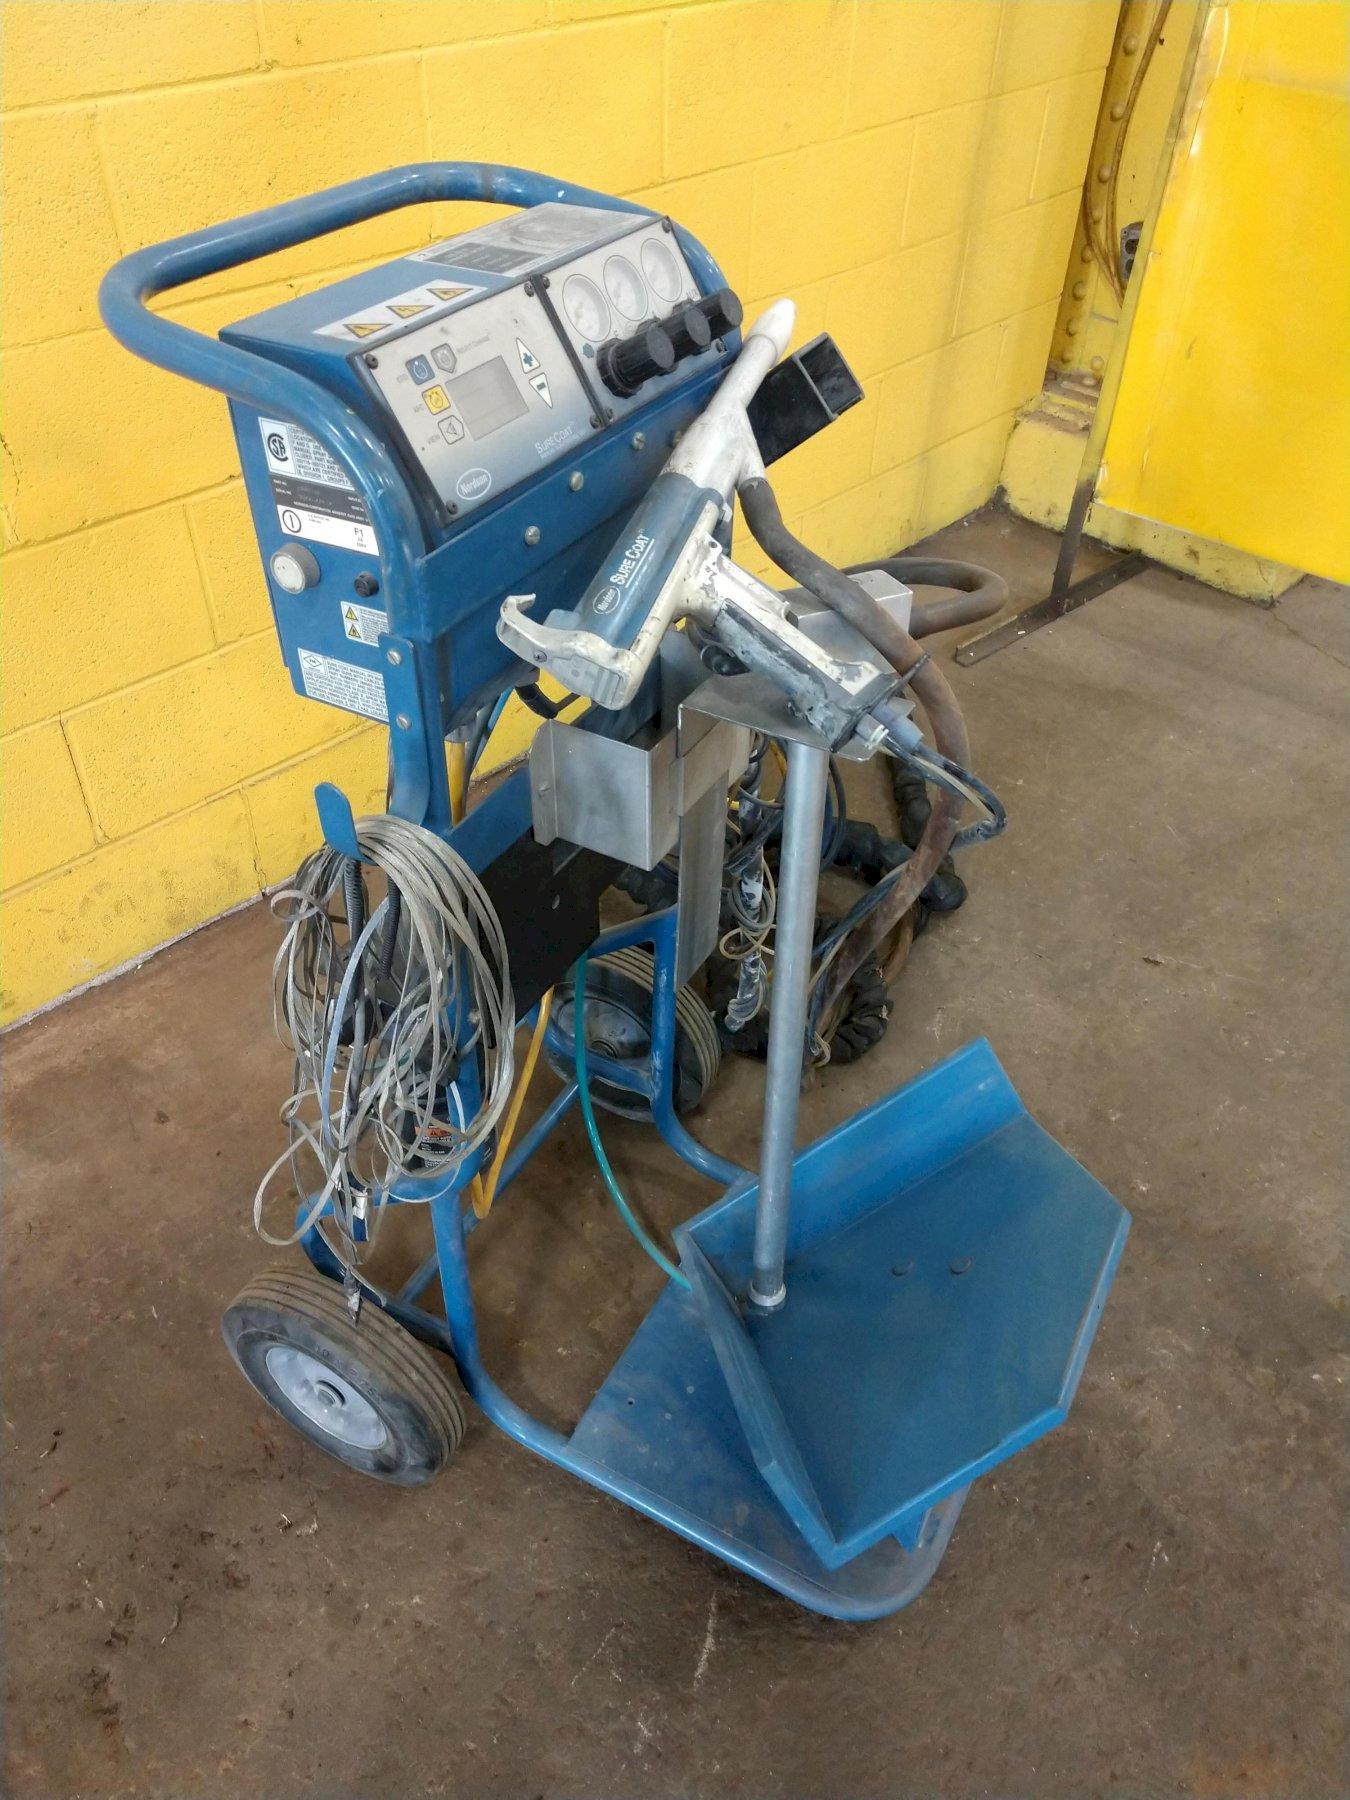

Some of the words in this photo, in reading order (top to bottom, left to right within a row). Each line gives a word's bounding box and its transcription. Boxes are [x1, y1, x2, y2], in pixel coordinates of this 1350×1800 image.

[535, 437, 553, 454] SURE
[460, 473, 489, 497] Nordson
[353, 527, 364, 538] F1
[596, 587, 617, 612] Nordson
[609, 558, 637, 585] SURE
